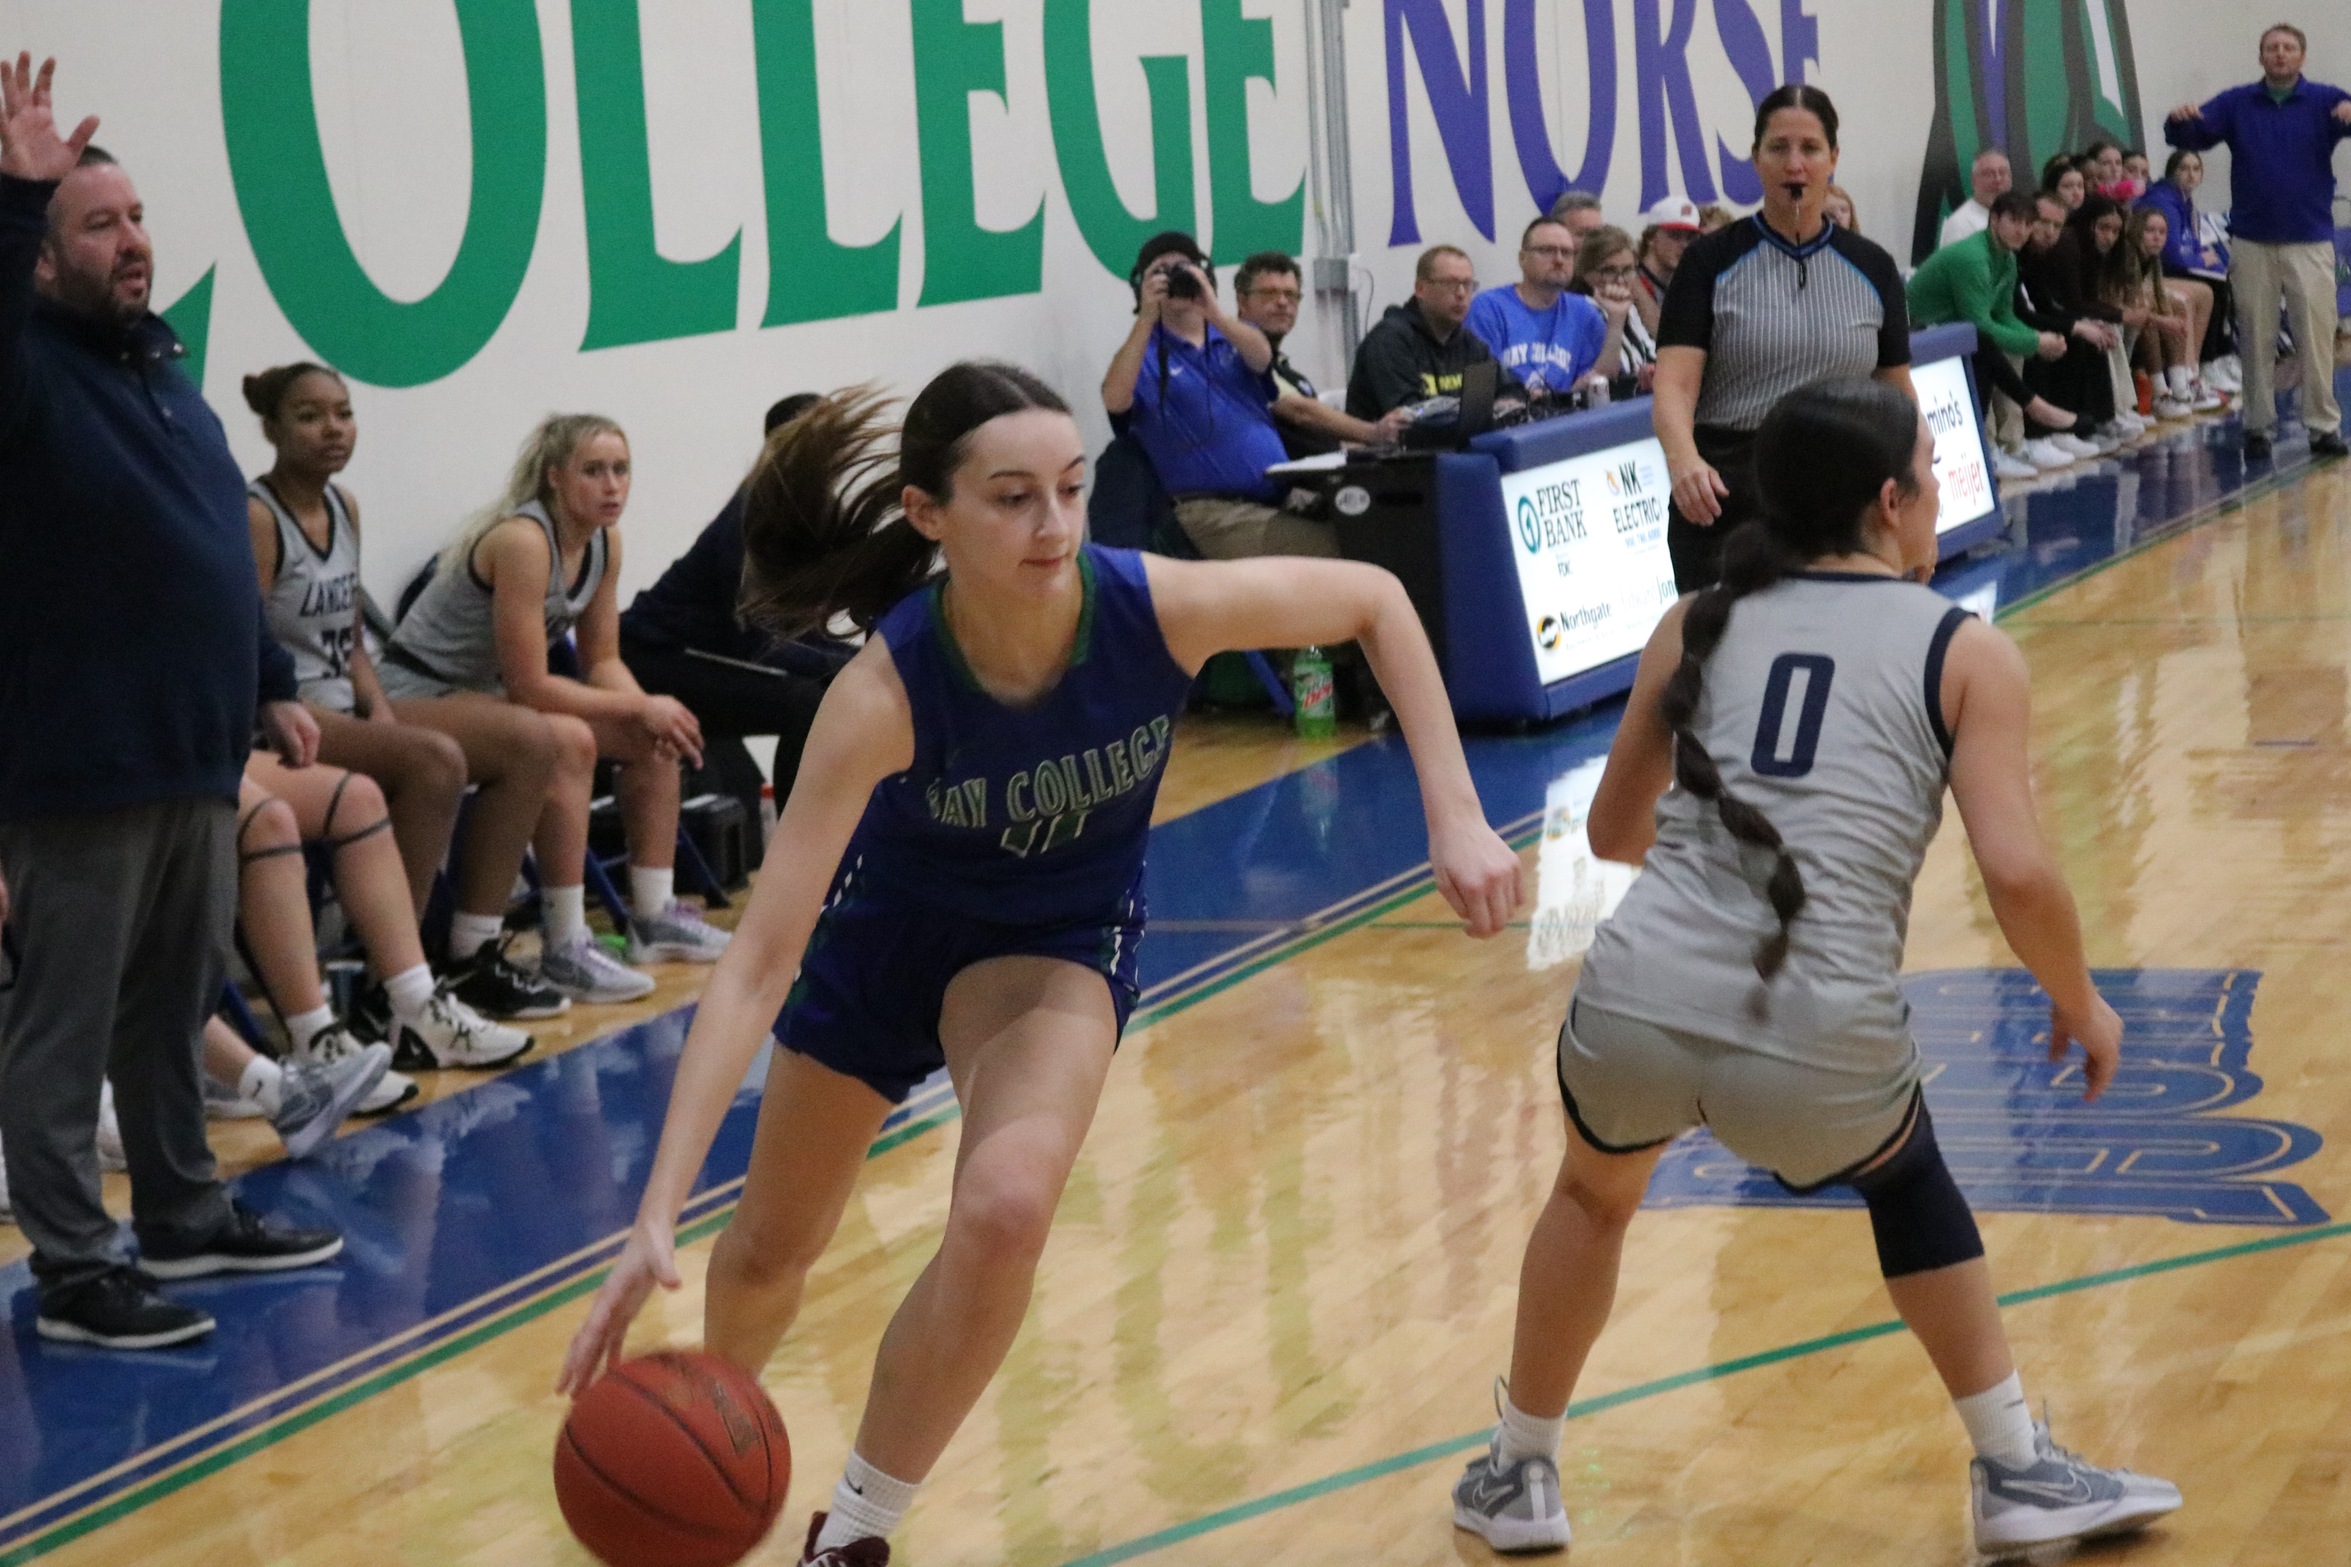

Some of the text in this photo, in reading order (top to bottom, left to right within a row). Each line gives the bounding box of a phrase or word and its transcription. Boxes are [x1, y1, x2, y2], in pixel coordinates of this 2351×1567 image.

[161, 0, 1305, 392] OLLEGE
[1537, 478, 1582, 517] FIRST
[1619, 460, 1642, 497] NK
[1948, 453, 1984, 505] meijer
[1544, 510, 1588, 548] BANK
[1560, 602, 1612, 632] Northgate
[1751, 653, 1835, 778] 0
